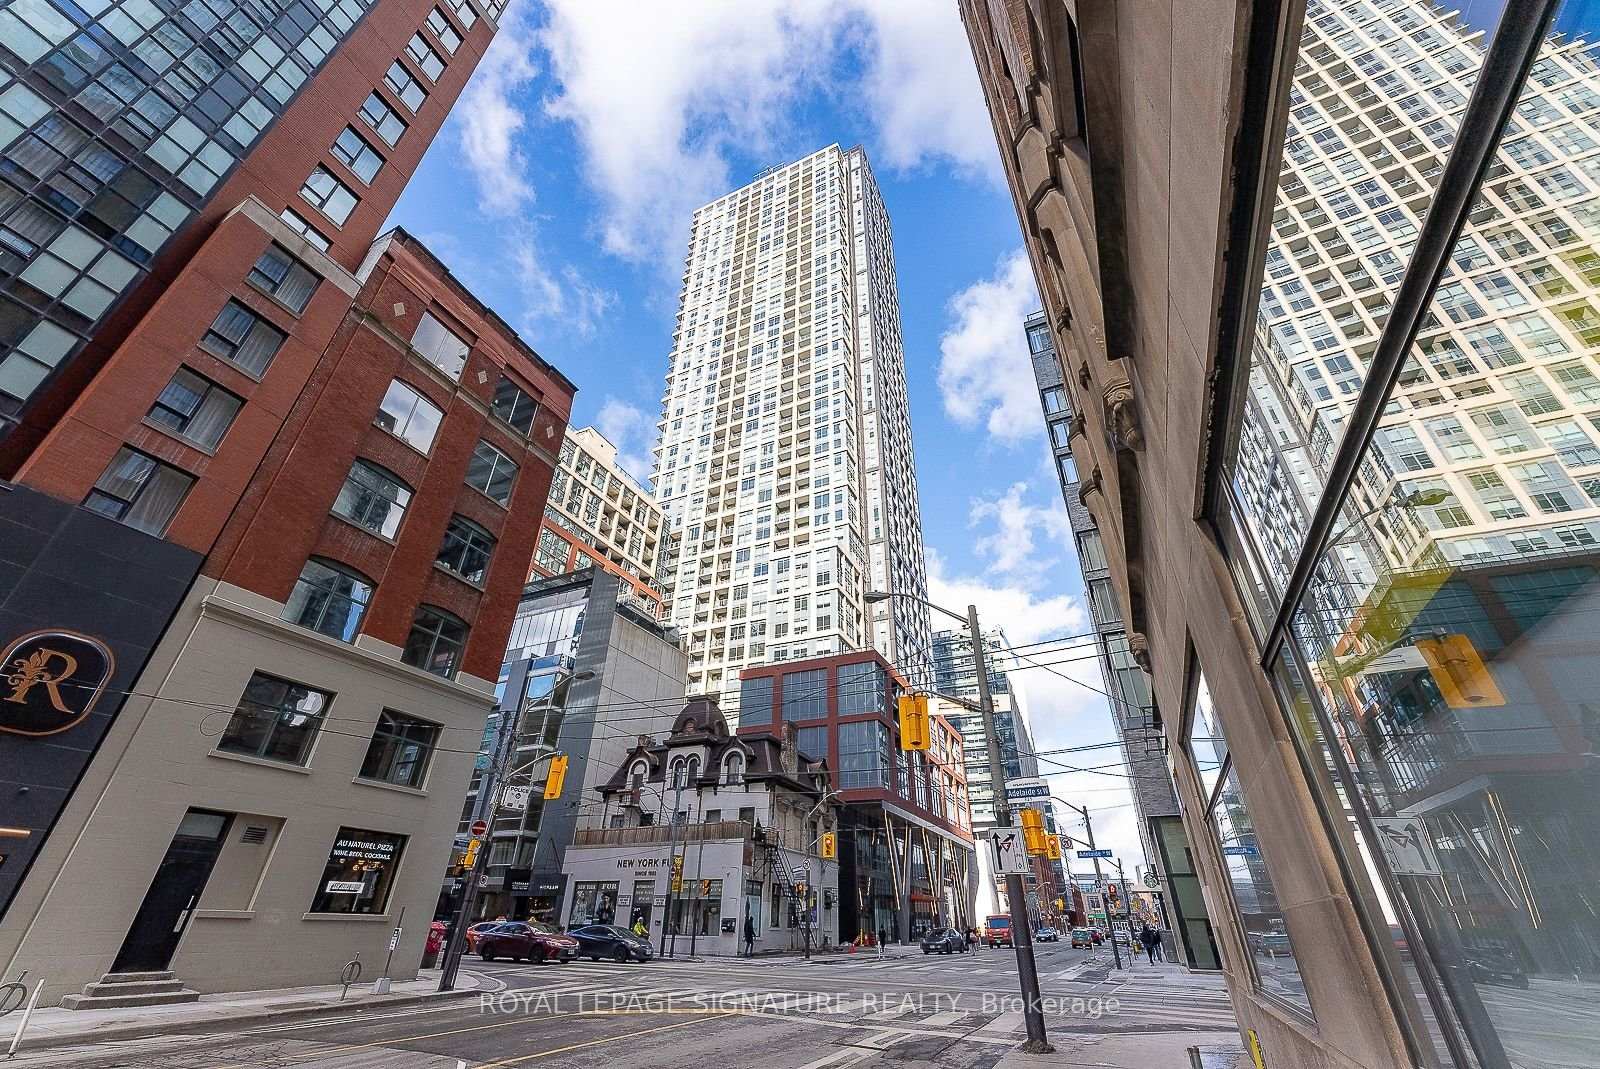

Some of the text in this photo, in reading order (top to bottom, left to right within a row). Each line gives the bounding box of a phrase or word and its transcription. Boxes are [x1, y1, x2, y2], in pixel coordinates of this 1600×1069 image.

[3, 647, 78, 714] R
[1008, 787, 1036, 797] Adelaide
[348, 841, 376, 850] NATUREL
[376, 843, 394, 852] PIZZA
[617, 859, 634, 868] NEW
[637, 859, 660, 868] YORK
